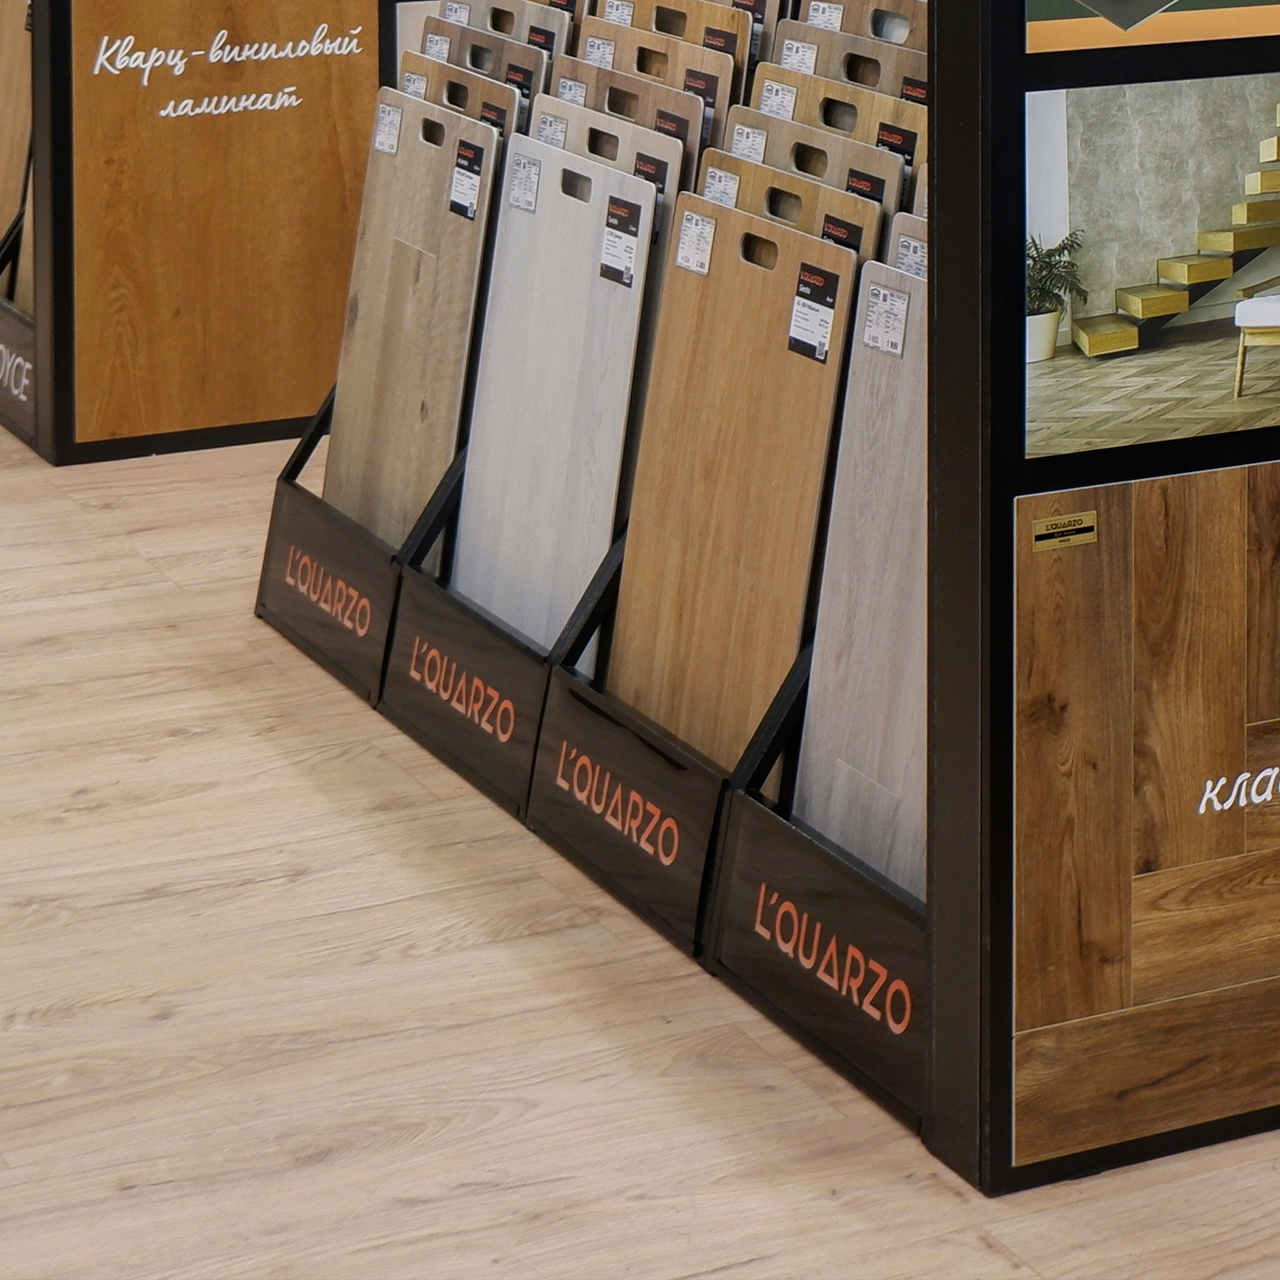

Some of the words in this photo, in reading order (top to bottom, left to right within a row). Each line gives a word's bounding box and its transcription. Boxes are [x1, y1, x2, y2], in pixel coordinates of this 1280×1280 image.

[93, 24, 364, 86] Кварц-виниловый
[159, 86, 304, 118] ламинат
[285, 545, 370, 638] L'QUARZO
[409, 636, 516, 743] L'QUARZO
[556, 740, 680, 866] L'QUARZO
[754, 881, 912, 1034] L'QUARZO
